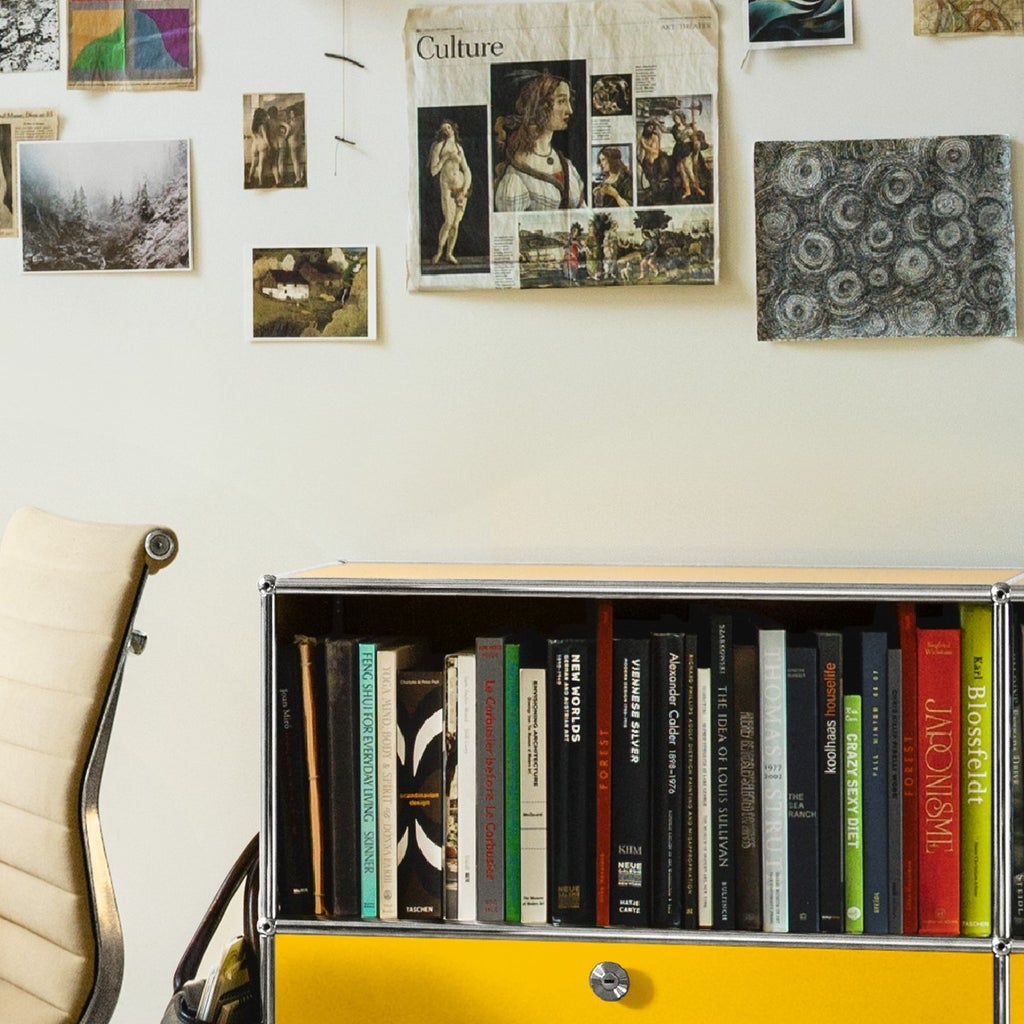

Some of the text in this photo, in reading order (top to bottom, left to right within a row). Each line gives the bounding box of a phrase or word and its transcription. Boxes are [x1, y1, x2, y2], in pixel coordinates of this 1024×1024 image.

[416, 34, 504, 60] Culture
[718, 624, 726, 674] SZARKOWSKI
[571, 654, 580, 743] NEW WORLDS
[668, 652, 680, 705] Alexander
[718, 686, 729, 710] THE
[764, 647, 783, 756] THOMAS
[630, 659, 640, 763] VIENNESE SILVER
[668, 709, 680, 745] Calder
[718, 714, 729, 742] IDEA
[823, 662, 837, 774] koolhaas houselife
[967, 656, 987, 805] Karl Blossfeldt
[362, 652, 374, 874] FENG SHUI FOR EVERYDAY LIVING SKINNER
[600, 730, 609, 790] FOREST
[718, 746, 729, 762] OF
[846, 733, 859, 776] CRAZY
[904, 736, 914, 797] FOREST
[925, 698, 953, 854] JAPONISME
[485, 680, 496, 880] Le Corbusier before Le Corbusier
[718, 767, 729, 803] LOUIS
[788, 793, 804, 801] THE
[846, 779, 859, 814] SEXY
[618, 845, 642, 856] KHM
[718, 807, 729, 867] SULLIVAN
[846, 817, 859, 849] DIET
[1016, 873, 1024, 916] STEIDL
